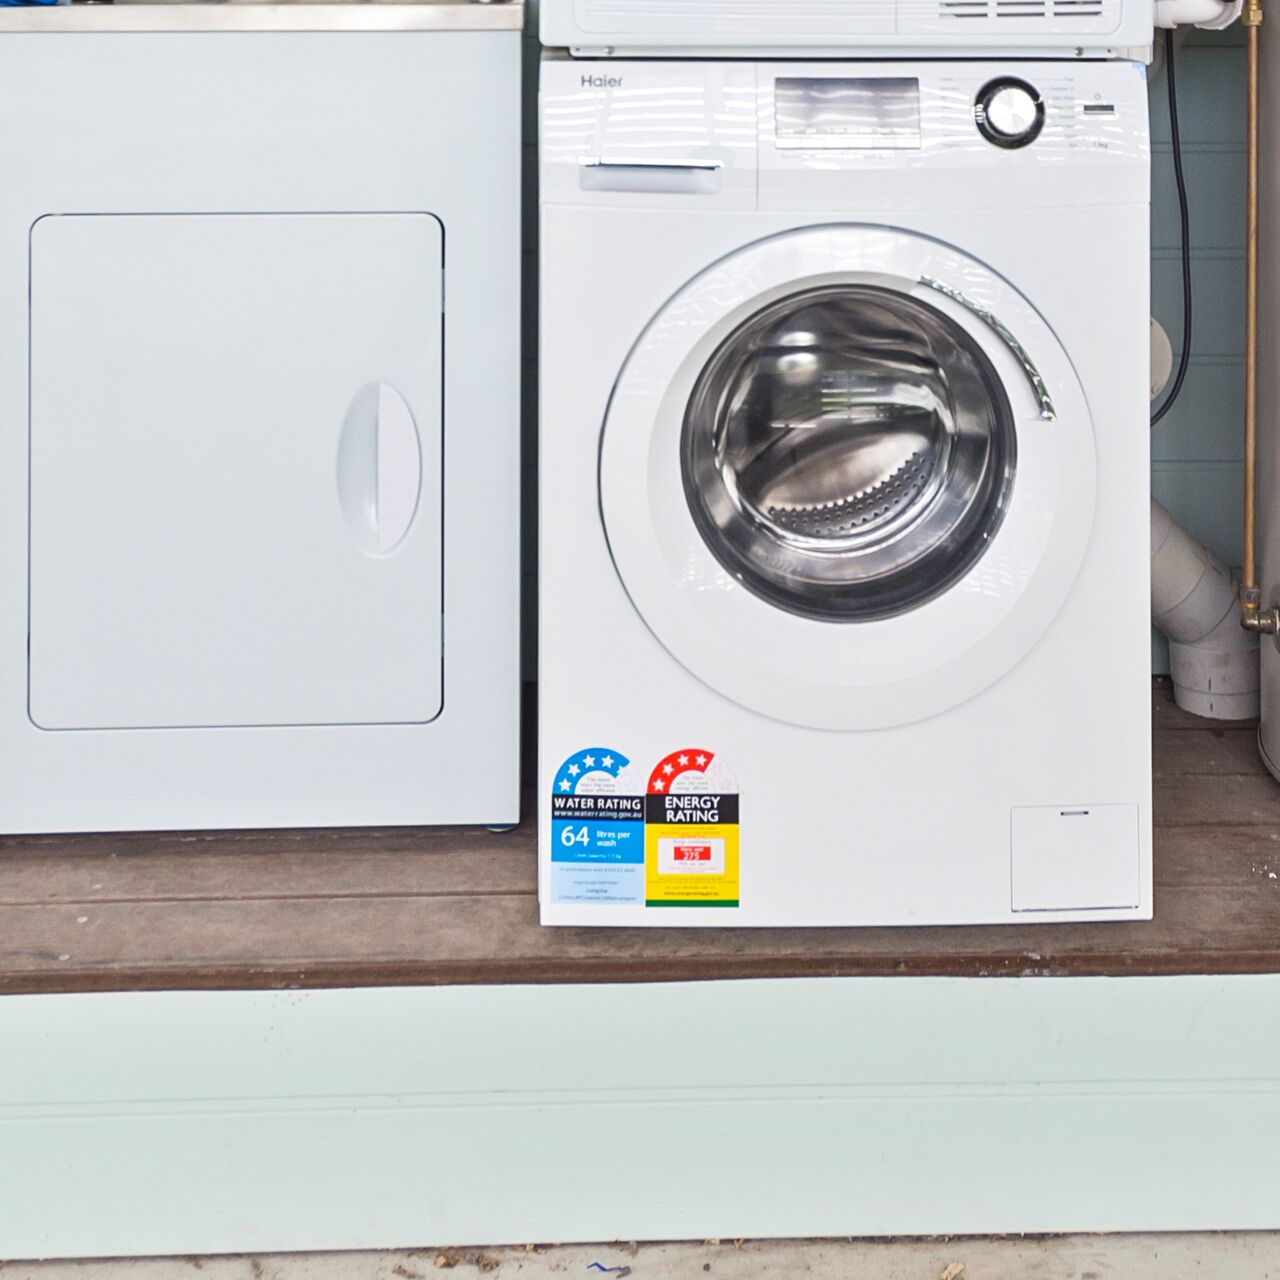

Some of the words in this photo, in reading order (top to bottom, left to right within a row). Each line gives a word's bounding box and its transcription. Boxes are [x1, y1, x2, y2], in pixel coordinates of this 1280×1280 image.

[581, 74, 623, 87] Haier
[554, 798, 594, 809] WATER
[597, 799, 641, 810] RATING
[665, 796, 720, 809] ENERGY
[666, 810, 719, 822] RATING
[561, 825, 590, 847] 64
[617, 831, 631, 840] per
